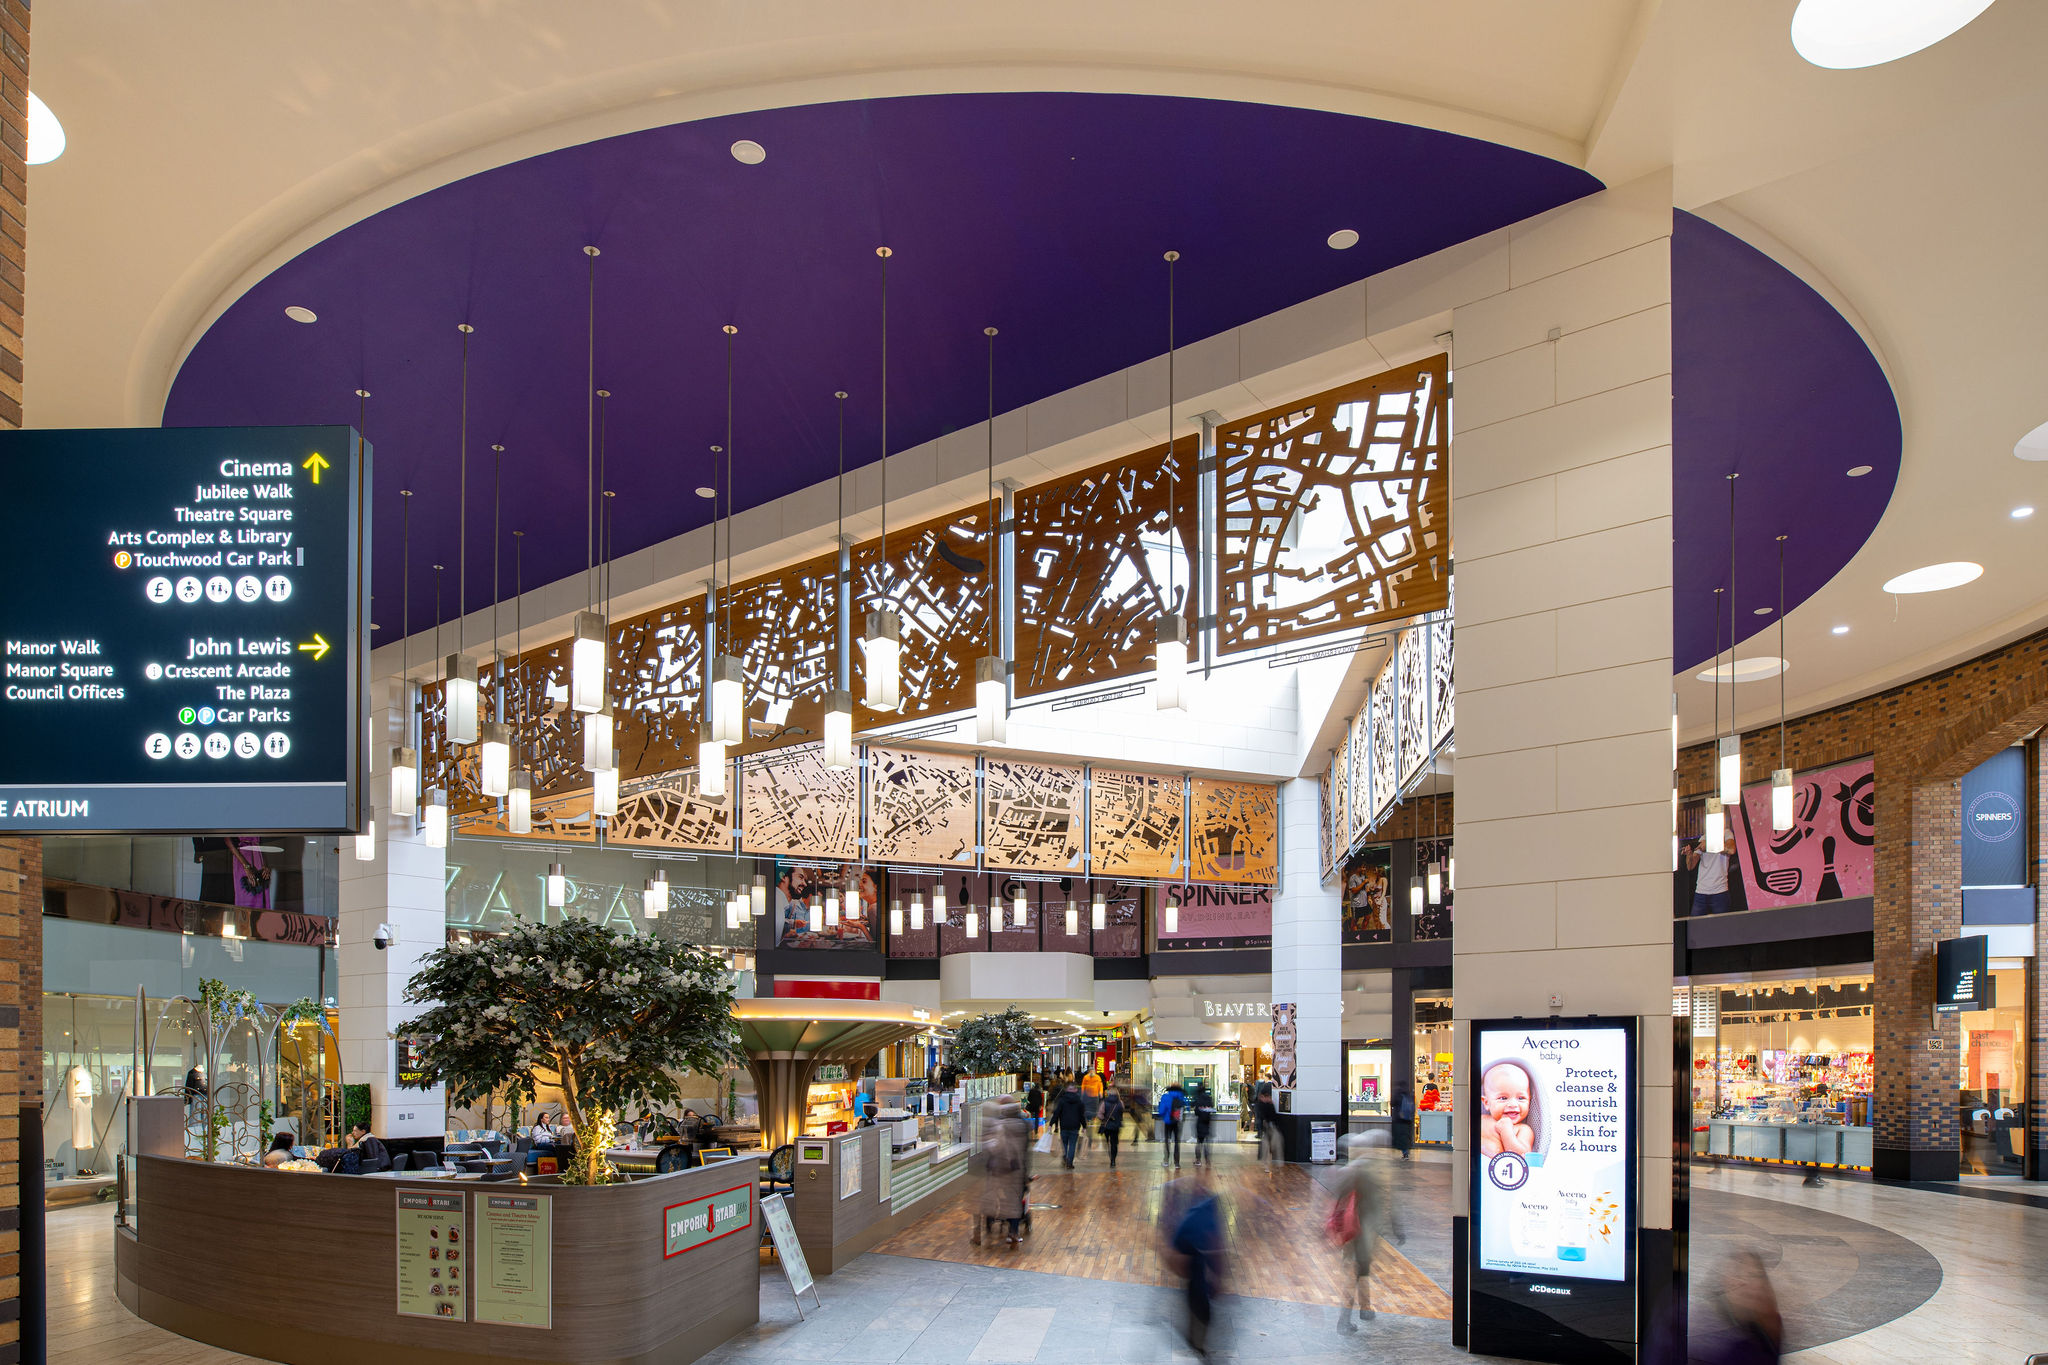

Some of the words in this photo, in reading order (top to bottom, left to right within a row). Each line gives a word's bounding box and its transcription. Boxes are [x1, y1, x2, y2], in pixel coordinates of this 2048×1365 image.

[219, 459, 293, 477] Cinema
[195, 484, 249, 502] Jubilee
[253, 484, 293, 499] Walk
[174, 507, 235, 522] Theatre
[239, 507, 293, 524] Square
[108, 531, 142, 545] Arts
[146, 530, 214, 548] Complex
[219, 530, 233, 544] &
[237, 529, 293, 547] Library
[134, 552, 222, 567] Touchwood
[226, 552, 253, 566] Car
[258, 551, 292, 566] Park
[6, 640, 57, 655] Manor
[61, 640, 100, 655] Walk
[187, 638, 232, 659] John
[238, 638, 291, 655] Lewis
[6, 664, 57, 677] Manor
[61, 664, 114, 679] Square
[164, 664, 233, 678] Crescent
[236, 664, 291, 678] Arcade
[6, 685, 64, 700] Council
[68, 685, 124, 700] Offices
[217, 686, 246, 700] The
[250, 685, 290, 700] Plaza
[217, 708, 244, 722] Car
[249, 708, 290, 722] Parks
[13, 800, 89, 817] ATRIUM
[1975, 812, 2013, 821] SPINNERS
[1168, 882, 1272, 907] SPINNER
[1203, 1000, 1272, 1017] BEAVER
[1522, 1036, 1580, 1050] Aveeno
[1971, 1031, 1989, 1040] Last
[1539, 1051, 1563, 1065] baby
[1565, 1067, 1618, 1080] Protect,
[1555, 1082, 1604, 1093] cleanse
[1607, 1082, 1618, 1093] &
[1566, 1096, 1618, 1109] nourish
[1559, 1111, 1618, 1123] sensitive
[1567, 1126, 1595, 1138] skin
[1598, 1126, 1618, 1138] for
[1560, 1142, 1576, 1153] 24
[1580, 1140, 1618, 1153] hours
[1501, 1162, 1513, 1179] #1
[1558, 1190, 1587, 1199] Aveeno
[670, 1213, 708, 1239] EMPORIO
[1529, 1284, 1571, 1296] JCDecaux
